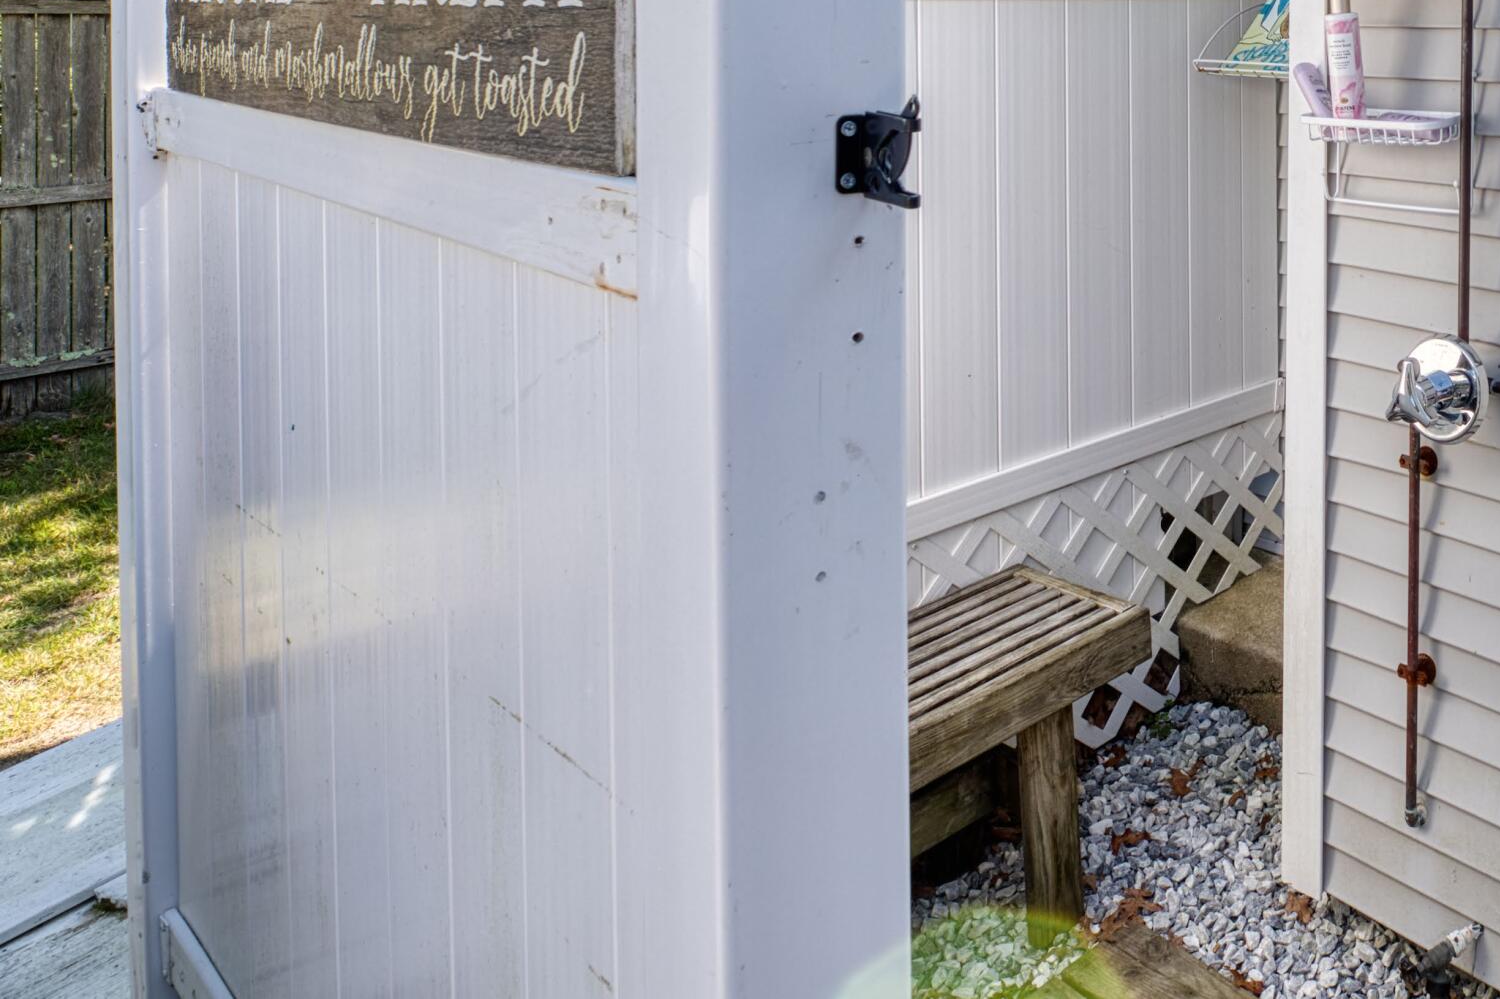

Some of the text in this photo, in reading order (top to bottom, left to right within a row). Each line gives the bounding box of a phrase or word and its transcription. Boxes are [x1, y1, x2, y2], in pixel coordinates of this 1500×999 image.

[200, 18, 237, 97] friends
[241, 20, 272, 89] and
[275, 22, 415, 121] marshmallows
[421, 42, 469, 143] get
[467, 31, 587, 137] toasted
